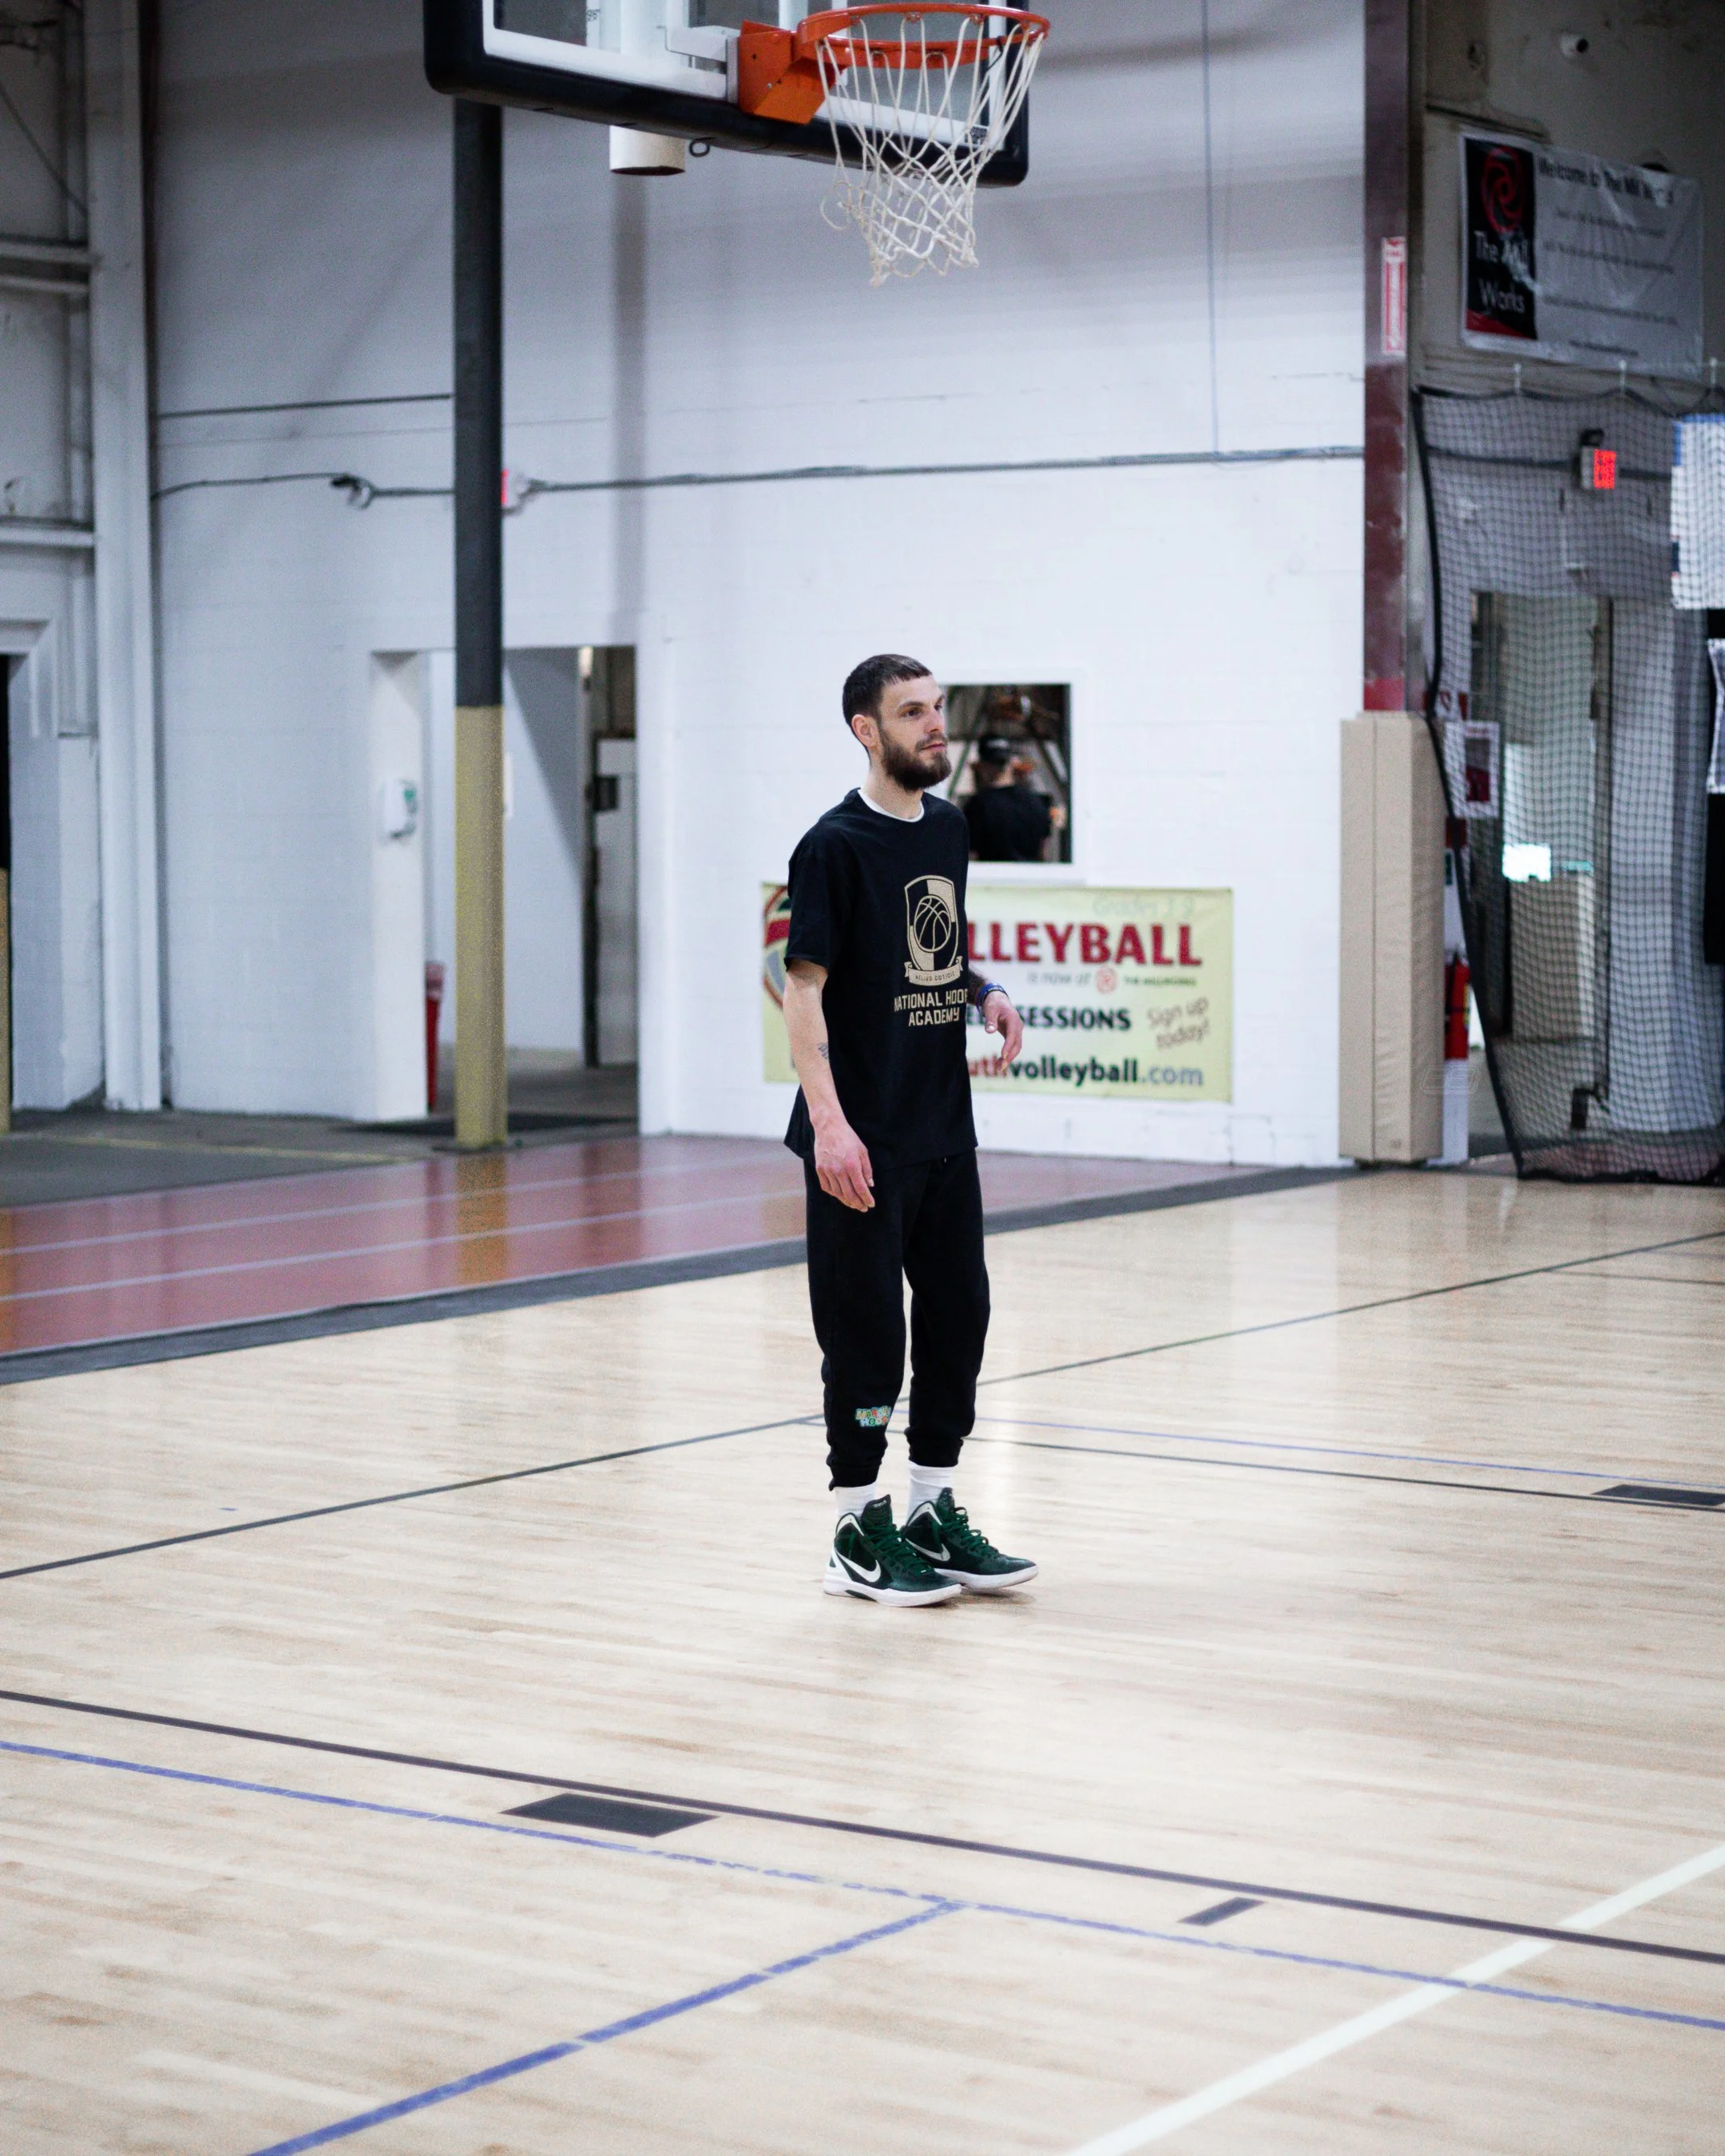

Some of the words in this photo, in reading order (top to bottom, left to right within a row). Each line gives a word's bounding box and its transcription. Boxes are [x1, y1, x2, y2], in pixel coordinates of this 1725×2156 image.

[967, 921, 1202, 966] LLEYBALL
[894, 992, 943, 1013] NATIONAL
[909, 1007, 960, 1027] ACADEMY
[1015, 1005, 1131, 1031] SESSIONS
[969, 1053, 1203, 1087] uthvolleyball.com
